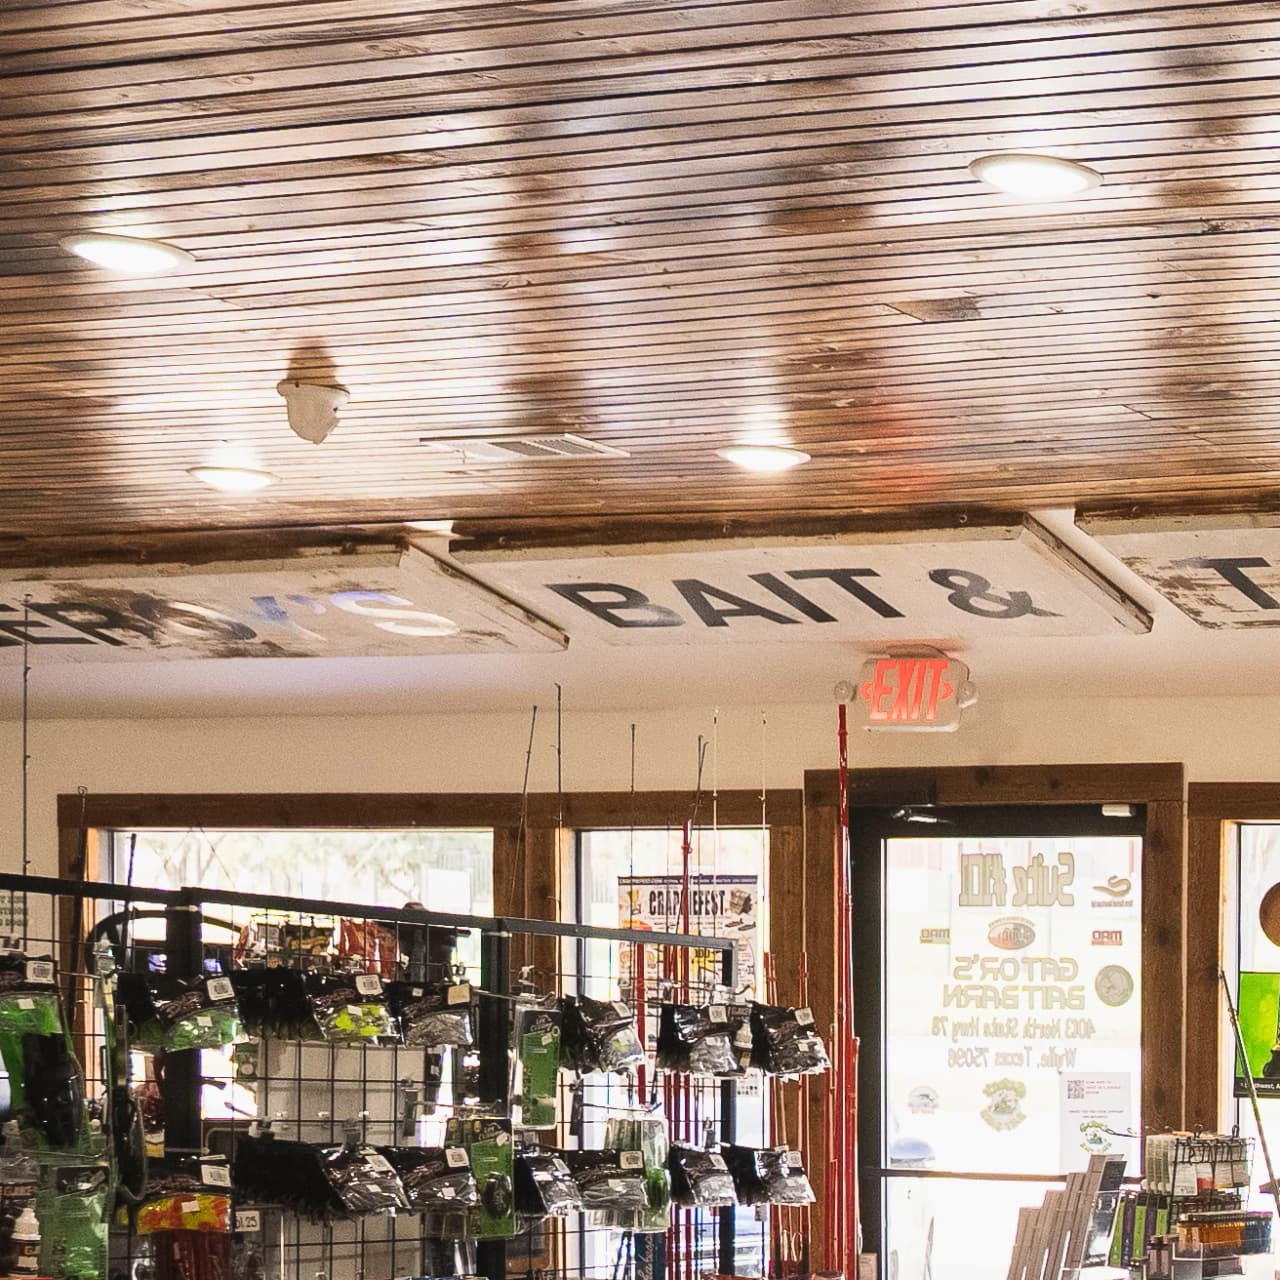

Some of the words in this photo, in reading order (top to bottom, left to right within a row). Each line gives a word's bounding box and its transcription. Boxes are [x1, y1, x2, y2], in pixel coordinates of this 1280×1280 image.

[546, 568, 905, 629] BAIT
[928, 567, 1062, 620] &
[870, 659, 949, 722] EXIT
[649, 889, 725, 917] CRAPIEFEST
